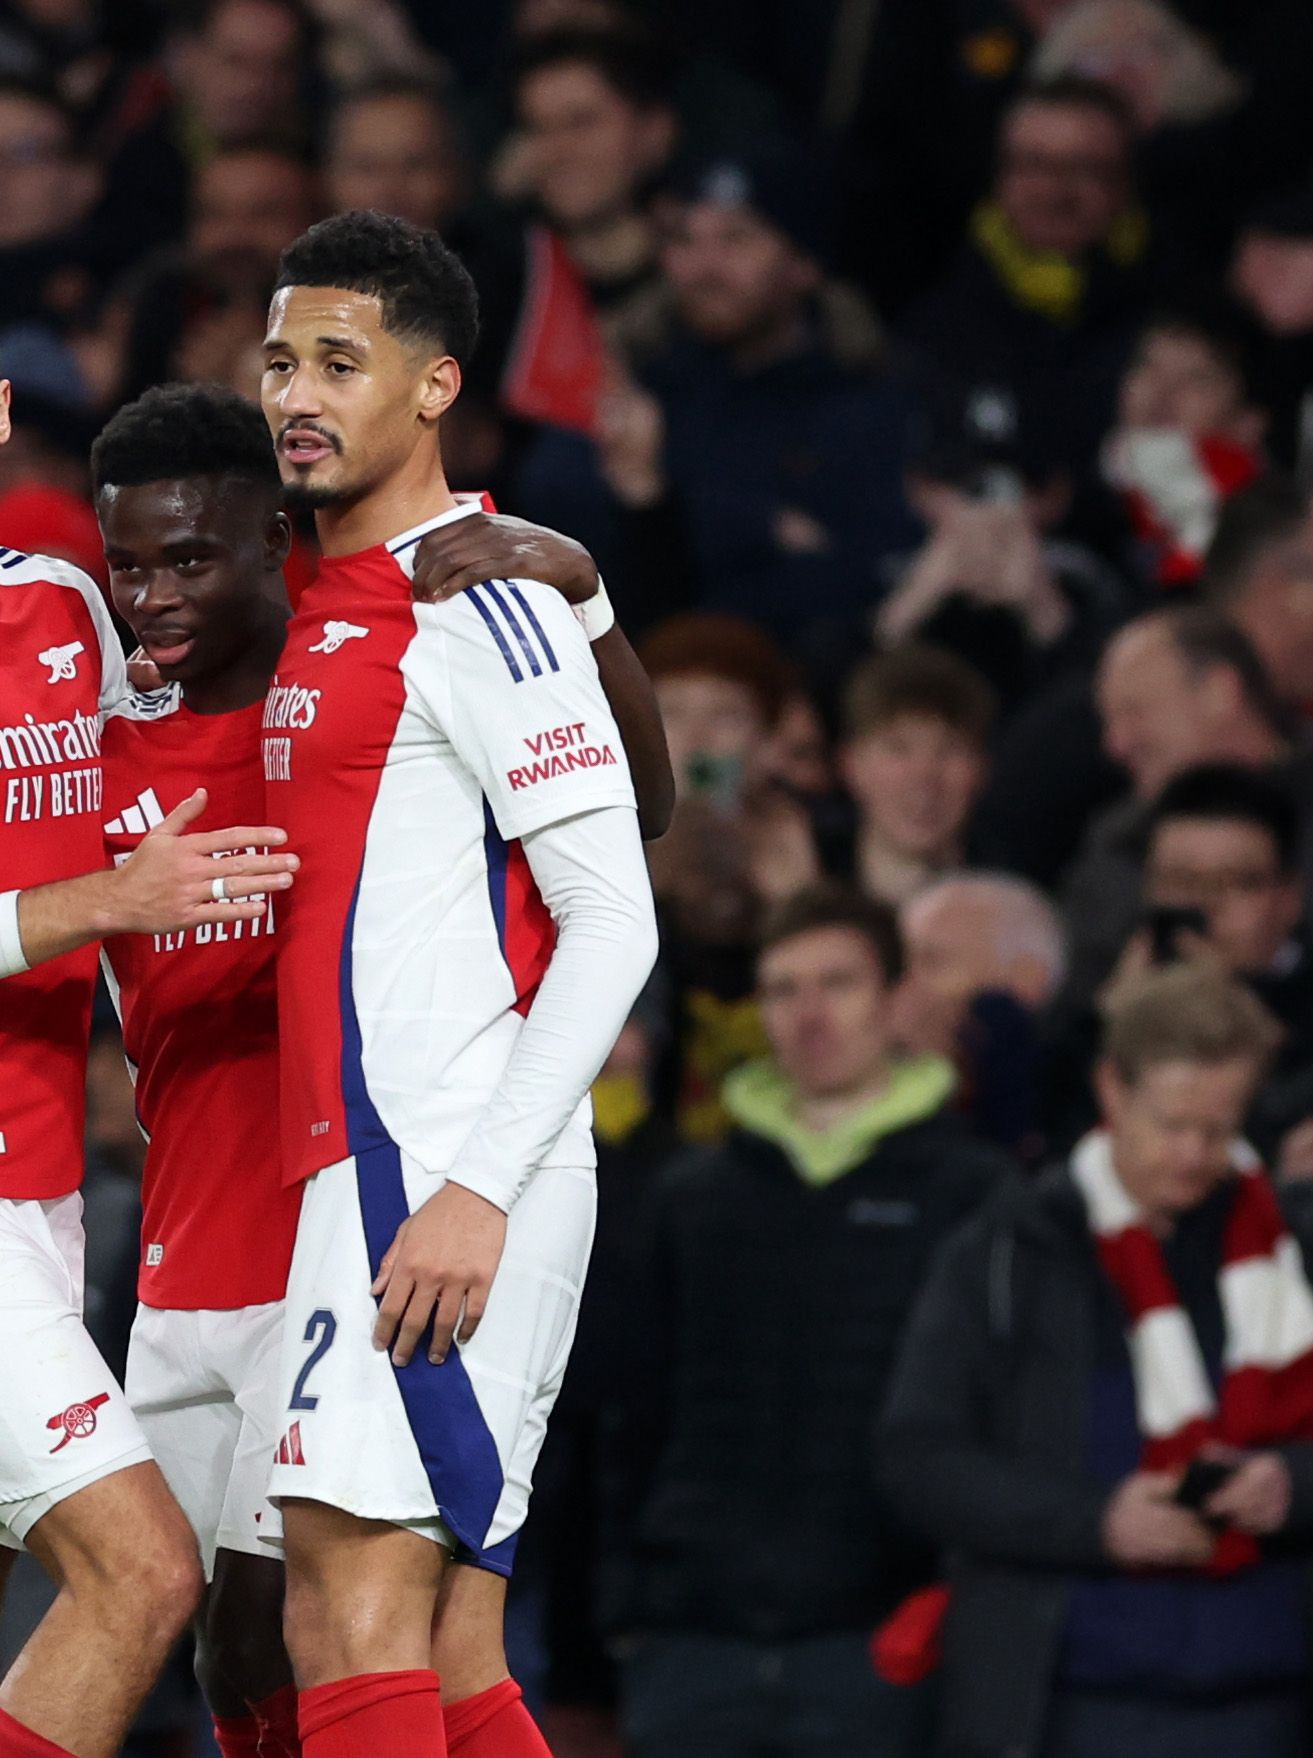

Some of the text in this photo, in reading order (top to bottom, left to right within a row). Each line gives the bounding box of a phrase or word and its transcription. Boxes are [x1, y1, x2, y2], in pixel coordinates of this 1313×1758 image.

[522, 722, 586, 757] VISIT
[506, 744, 618, 792] RWANDA
[5, 767, 102, 823] FLY BETTE
[287, 1307, 339, 1413] 2
